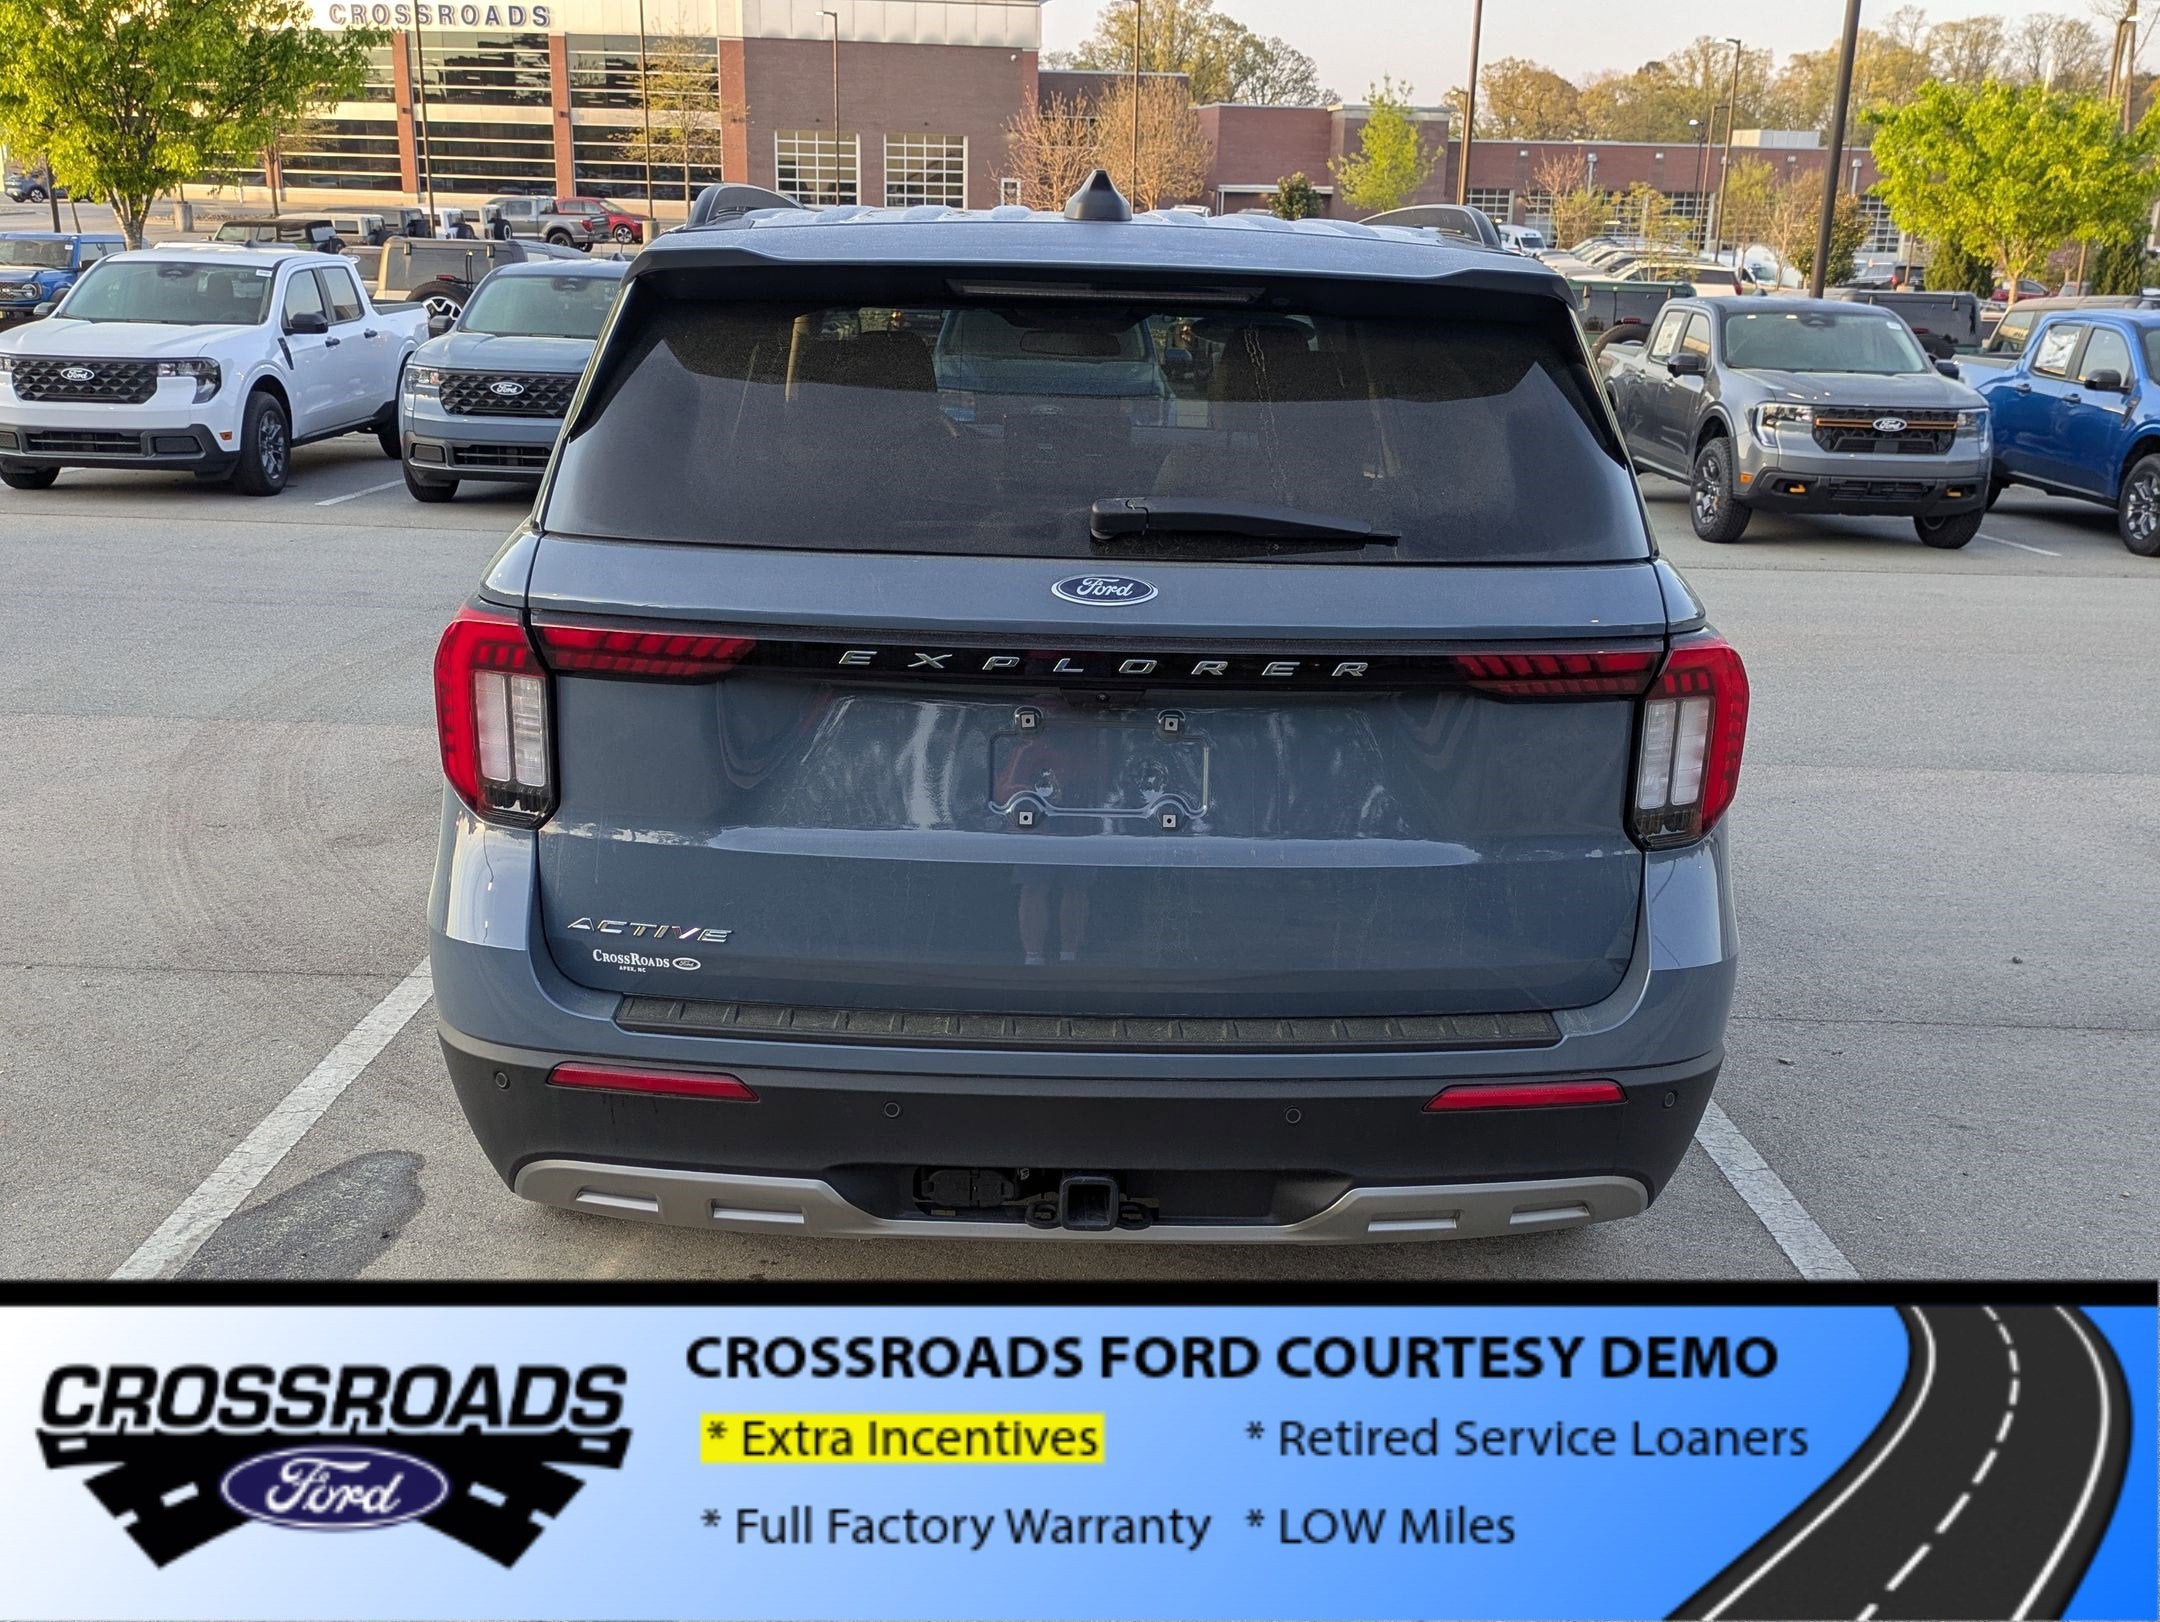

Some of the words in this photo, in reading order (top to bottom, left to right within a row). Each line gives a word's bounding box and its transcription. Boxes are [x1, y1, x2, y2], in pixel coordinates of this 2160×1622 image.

[329, 3, 551, 28] CROSSROADS
[1076, 577, 1135, 597] Ford
[838, 649, 1369, 678] EXPLORER
[567, 916, 733, 944] ACTIVE
